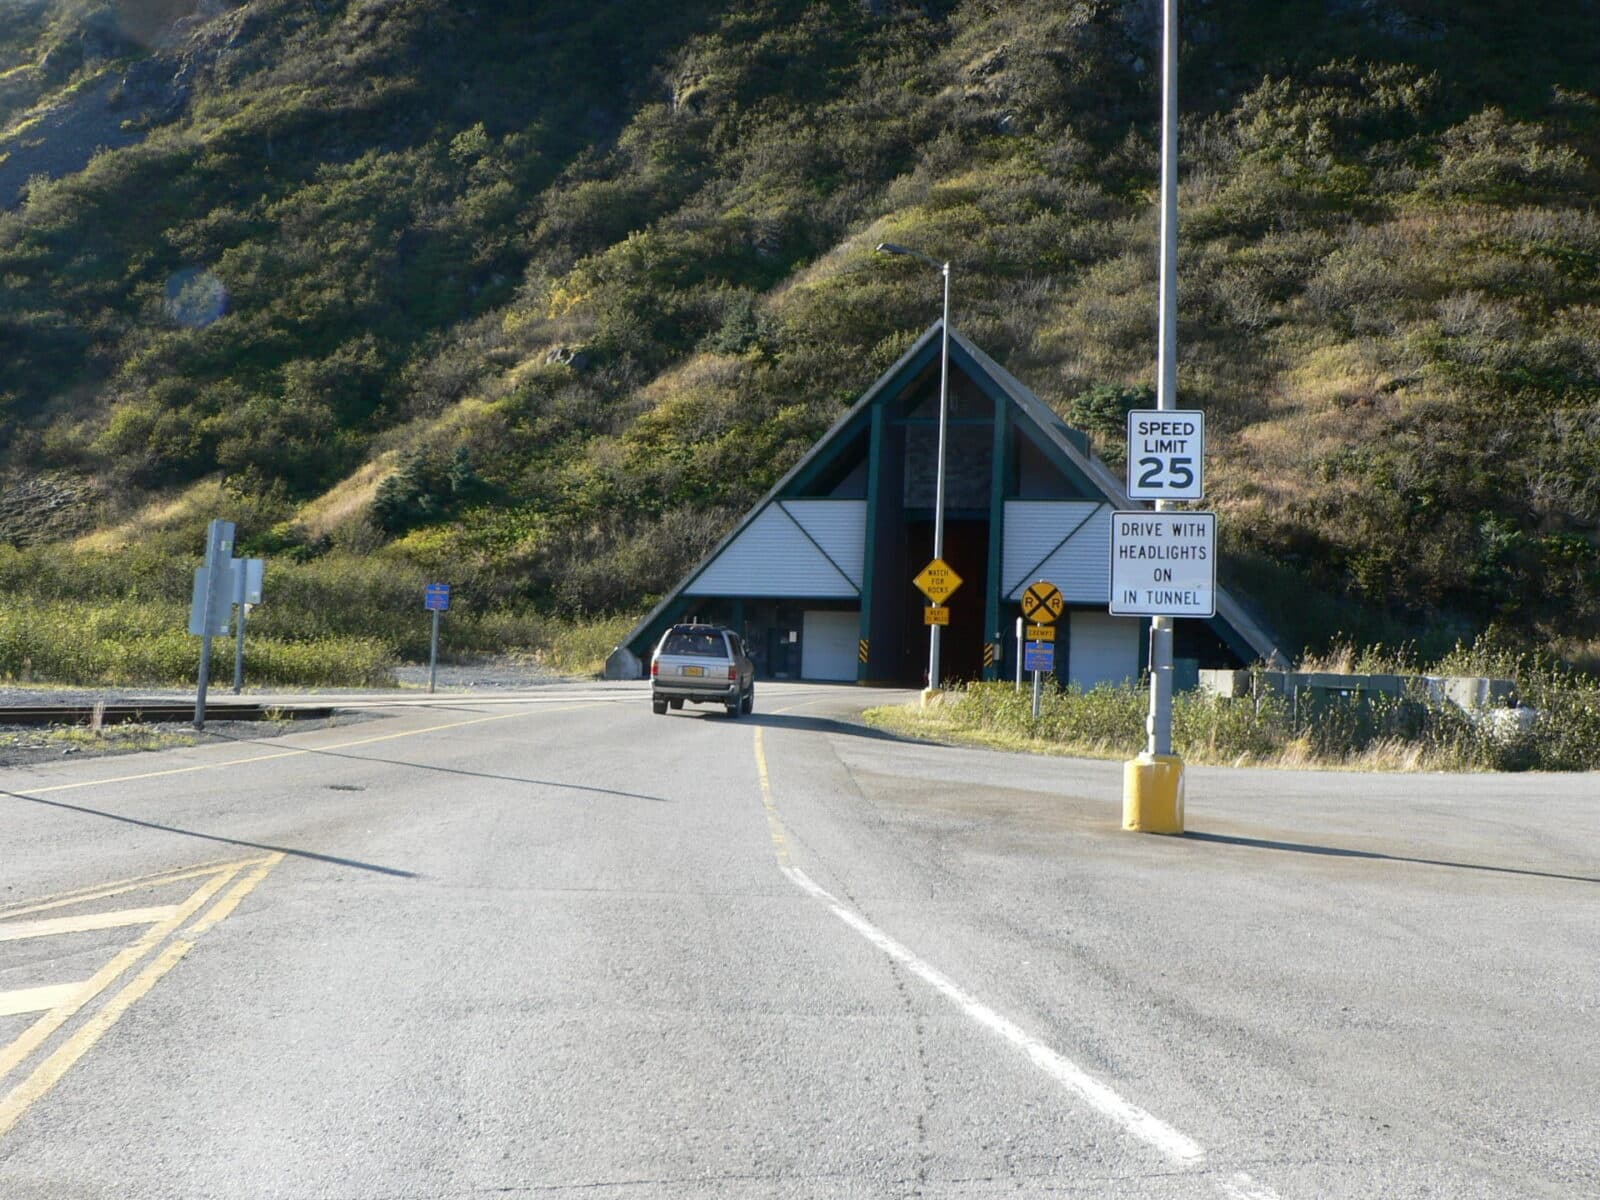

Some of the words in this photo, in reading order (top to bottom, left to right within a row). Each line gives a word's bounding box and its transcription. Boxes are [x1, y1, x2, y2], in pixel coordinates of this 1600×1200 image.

[1138, 422, 1195, 436] SPEED
[1144, 440, 1188, 453] LIMIT
[1138, 457, 1194, 489] 25
[1121, 523, 1163, 537] DRIVE
[1172, 523, 1206, 537] WITH
[1119, 545, 1207, 560] HEADLIGHTS
[928, 569, 949, 577] WATCH
[1153, 568, 1172, 582] ON
[1025, 597, 1034, 607] R
[1052, 598, 1061, 608] R
[1123, 590, 1137, 604] IN
[1146, 590, 1200, 605] TUNNEL
